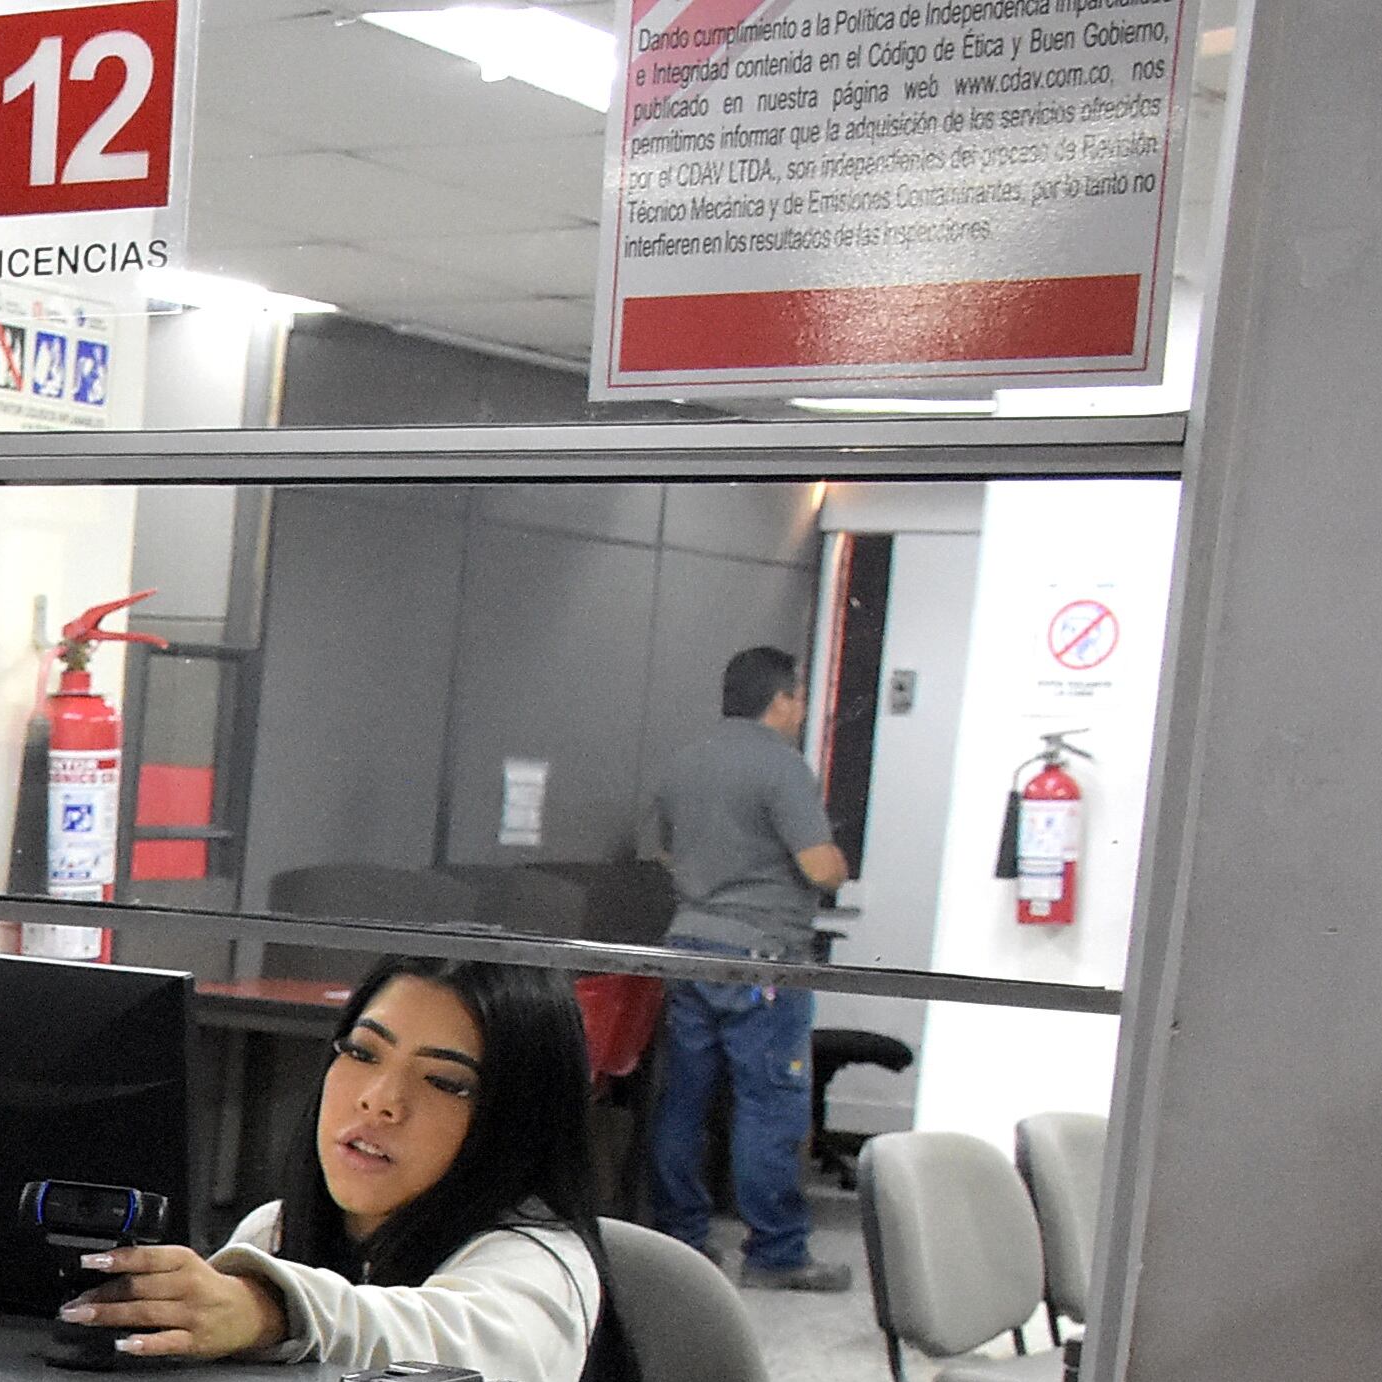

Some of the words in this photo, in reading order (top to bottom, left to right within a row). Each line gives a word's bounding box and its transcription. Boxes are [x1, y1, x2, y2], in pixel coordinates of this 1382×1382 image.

[637, 67, 645, 86] e
[652, 57, 729, 89] Integridad
[736, 49, 812, 78] contenida
[819, 49, 839, 71] en
[846, 44, 861, 68] el
[868, 37, 926, 71] Código
[933, 38, 954, 61] de
[963, 28, 1004, 59] Ética
[1011, 35, 1021, 60] y
[1030, 27, 1075, 53] Buen
[1084, 20, 1168, 48] Gobierno,
[639, 28, 688, 51] Dando
[693, 15, 796, 48] cumplimiento
[801, 18, 811, 37] a
[816, 13, 829, 35] la
[836, 7, 894, 34] Política
[899, 8, 919, 29] de
[925, 0, 1049, 27] Independencia
[3, 30, 154, 186] 12
[633, 93, 709, 127] publicado
[723, 92, 743, 114] en
[757, 85, 817, 112] nuestra
[832, 80, 888, 111] página
[905, 75, 938, 99] web
[1131, 57, 1166, 81] nos
[630, 129, 715, 158] permitimos
[720, 123, 784, 149] informar
[790, 123, 819, 148] que
[825, 118, 840, 142] la
[845, 111, 937, 145] adquisición
[943, 109, 964, 134] de
[970, 106, 994, 130] los
[1000, 101, 1075, 129] servicios
[1080, 94, 1162, 122] ofrecidos
[628, 198, 685, 224] Técnico
[690, 193, 763, 220] Mecánica
[768, 199, 780, 222] y
[784, 192, 804, 215] de
[808, 188, 891, 214] Emisiones
[1085, 172, 1129, 197] tanto
[1133, 172, 1156, 194] no
[629, 167, 653, 196] por
[658, 163, 672, 186] el
[676, 160, 723, 187] CDAV
[786, 158, 817, 181] son
[624, 231, 699, 259] interfieren
[703, 232, 721, 254] en
[725, 229, 745, 252] los
[750, 224, 830, 251] resultados
